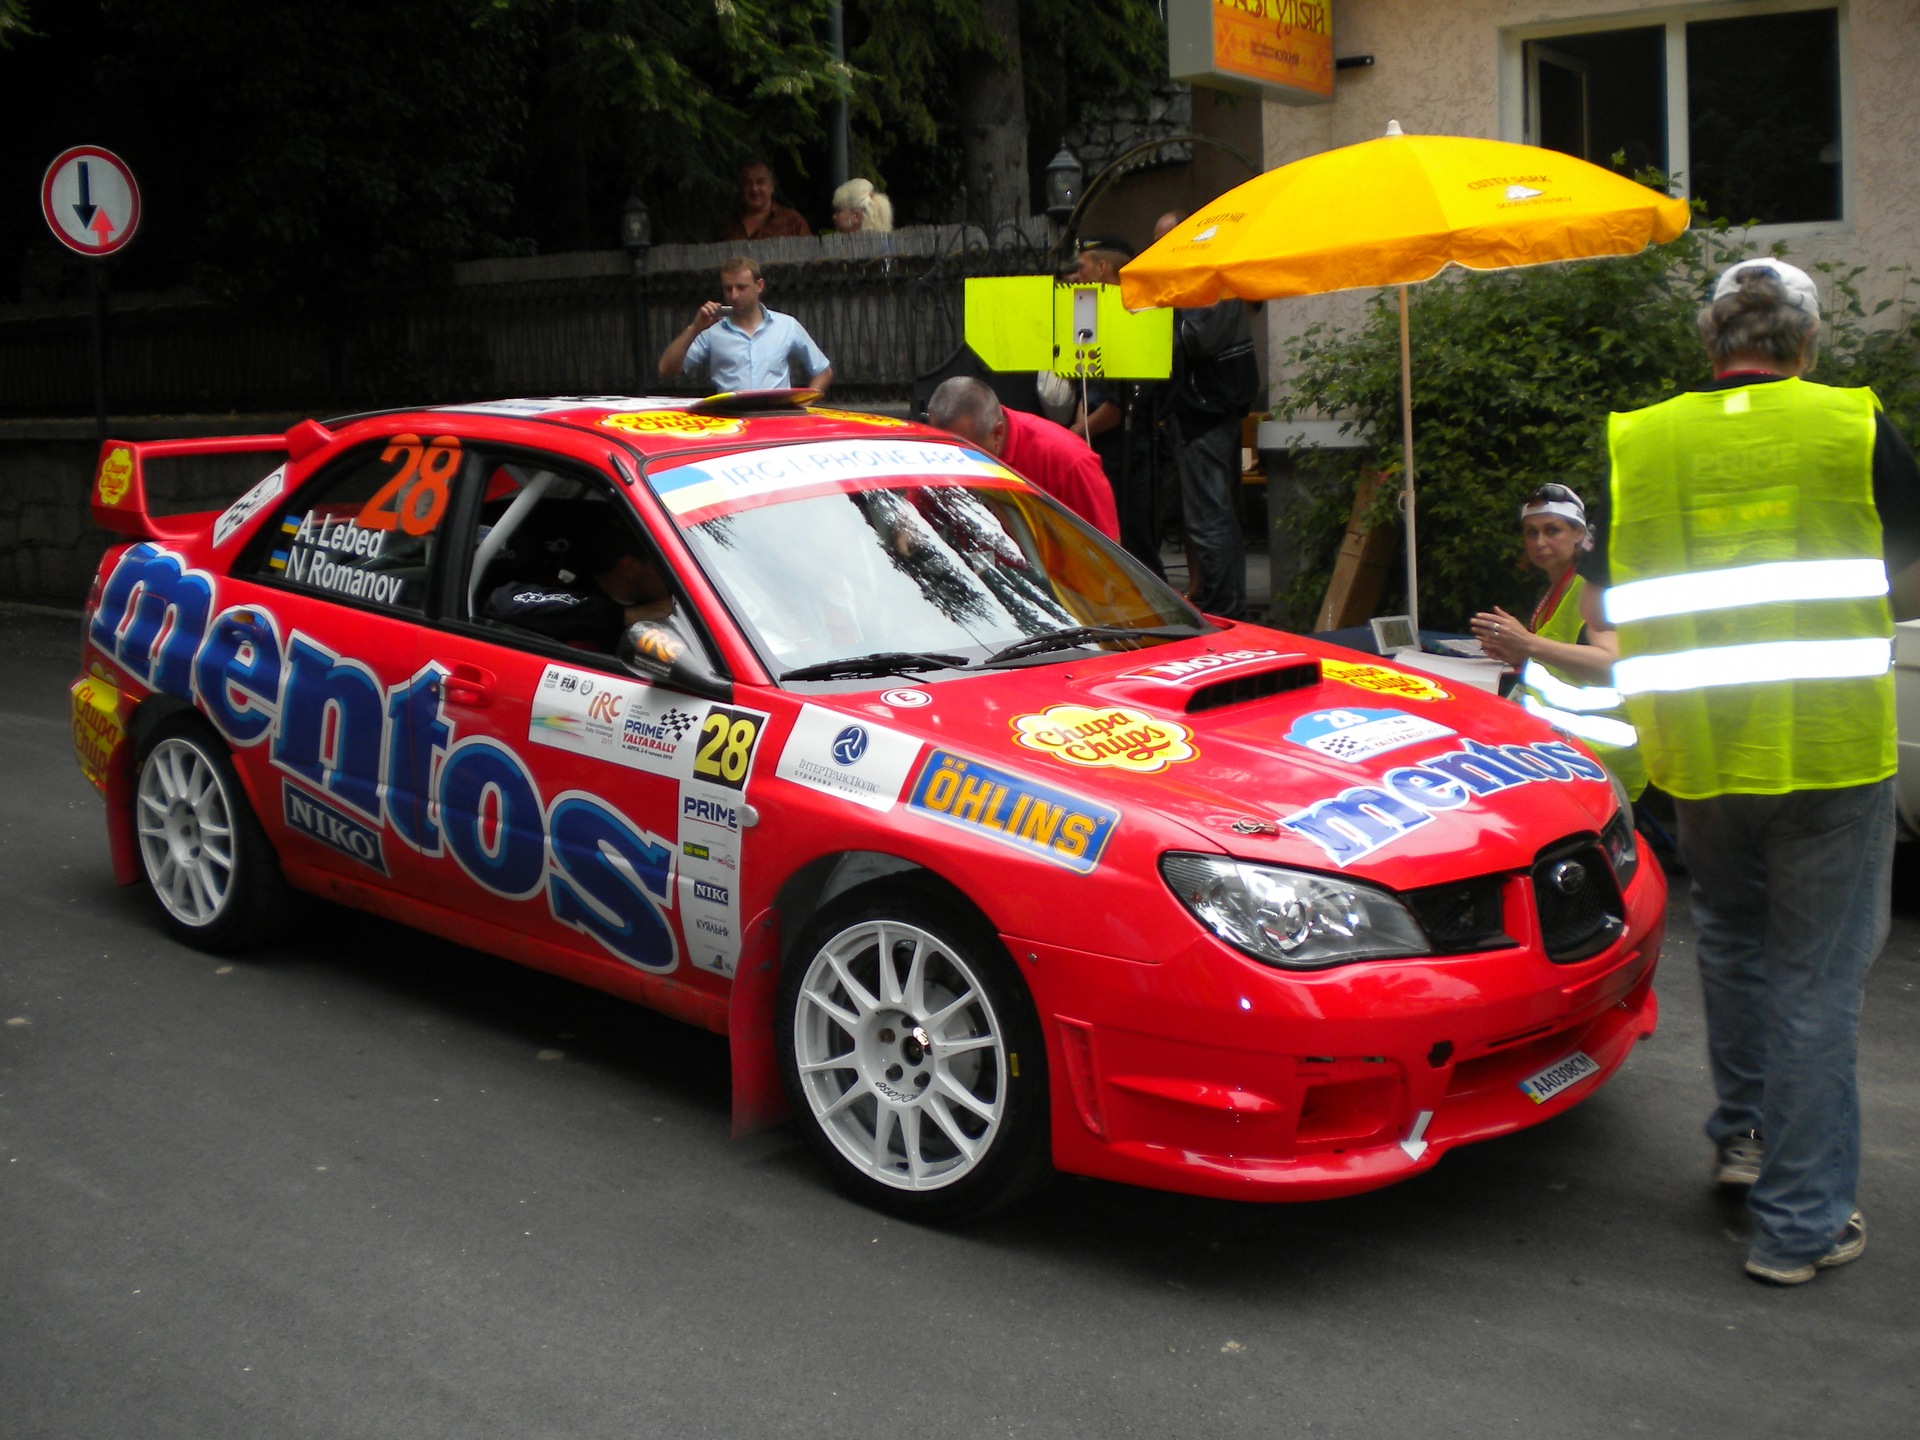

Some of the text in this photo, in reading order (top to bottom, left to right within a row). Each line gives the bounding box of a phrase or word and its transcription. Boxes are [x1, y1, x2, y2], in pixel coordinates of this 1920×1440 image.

[1467, 177, 1508, 190] CUTTY
[354, 433, 462, 536] 28
[719, 449, 968, 487] IRC I-PHONE APP
[294, 509, 385, 558] A. Lebed
[285, 545, 403, 604] N Romanov
[76, 685, 118, 745] Chupa
[894, 692, 917, 702] E
[1312, 709, 1368, 729] 28
[623, 732, 677, 754] YALTARALLY
[624, 719, 665, 740] PRIME
[693, 713, 756, 782] 28
[1035, 710, 1132, 750] Chupa
[1065, 719, 1172, 765] Chups
[86, 541, 681, 975] mentos
[684, 796, 738, 829] PRIME
[1277, 737, 1607, 868] mentos
[289, 792, 377, 862] NIKO
